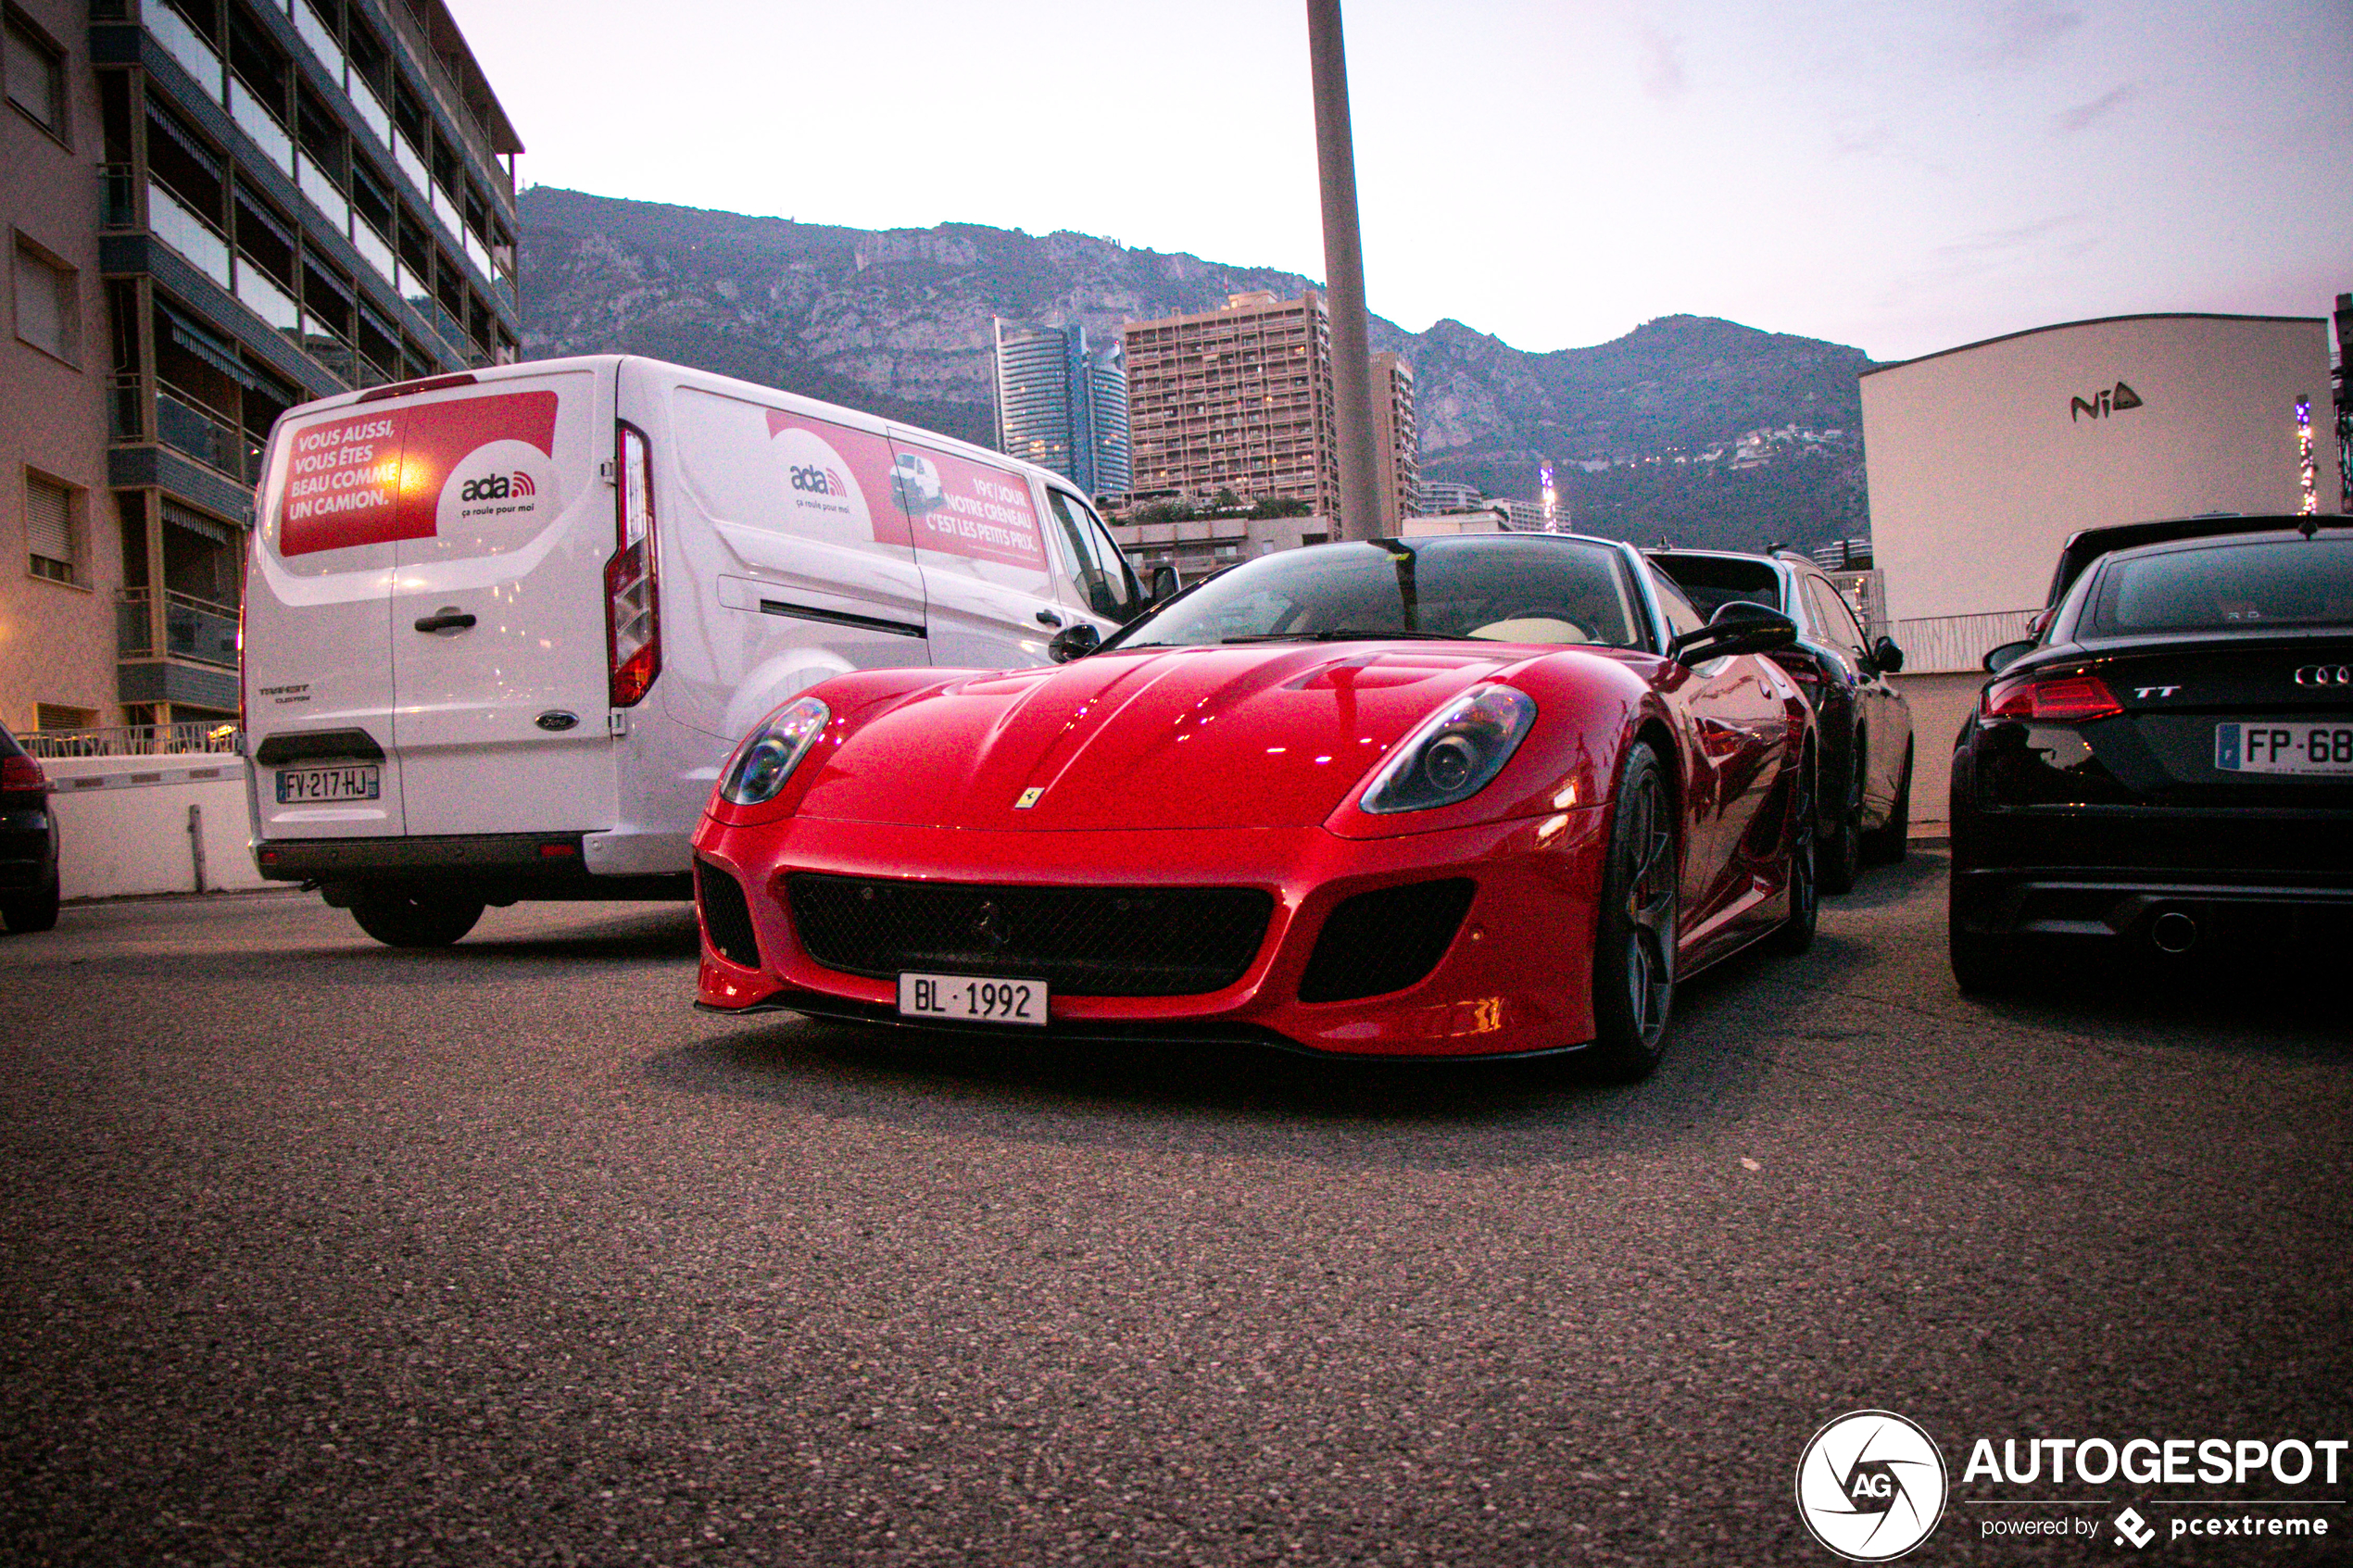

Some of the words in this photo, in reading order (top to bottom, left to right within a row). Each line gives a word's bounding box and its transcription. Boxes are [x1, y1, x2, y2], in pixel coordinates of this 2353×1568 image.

[299, 429, 342, 453] VOUS
[341, 420, 395, 444] AUSSI,
[296, 451, 337, 475] VOUS
[338, 444, 374, 467] ÊTES
[291, 474, 331, 498] BEAU
[331, 462, 398, 490] COMME
[461, 473, 510, 502] ada
[790, 464, 829, 495] ada
[289, 500, 313, 521] UN
[314, 488, 390, 516] CAMION.
[461, 509, 471, 518] ça
[472, 506, 494, 515] roule
[496, 506, 517, 515] pour
[518, 503, 535, 512] moi
[944, 492, 985, 518] NOTRE
[925, 512, 958, 534] C'EST
[957, 519, 977, 539] LES
[976, 522, 1011, 546] PETITS
[1009, 530, 1038, 552] PRIX.
[2133, 685, 2182, 698] TT
